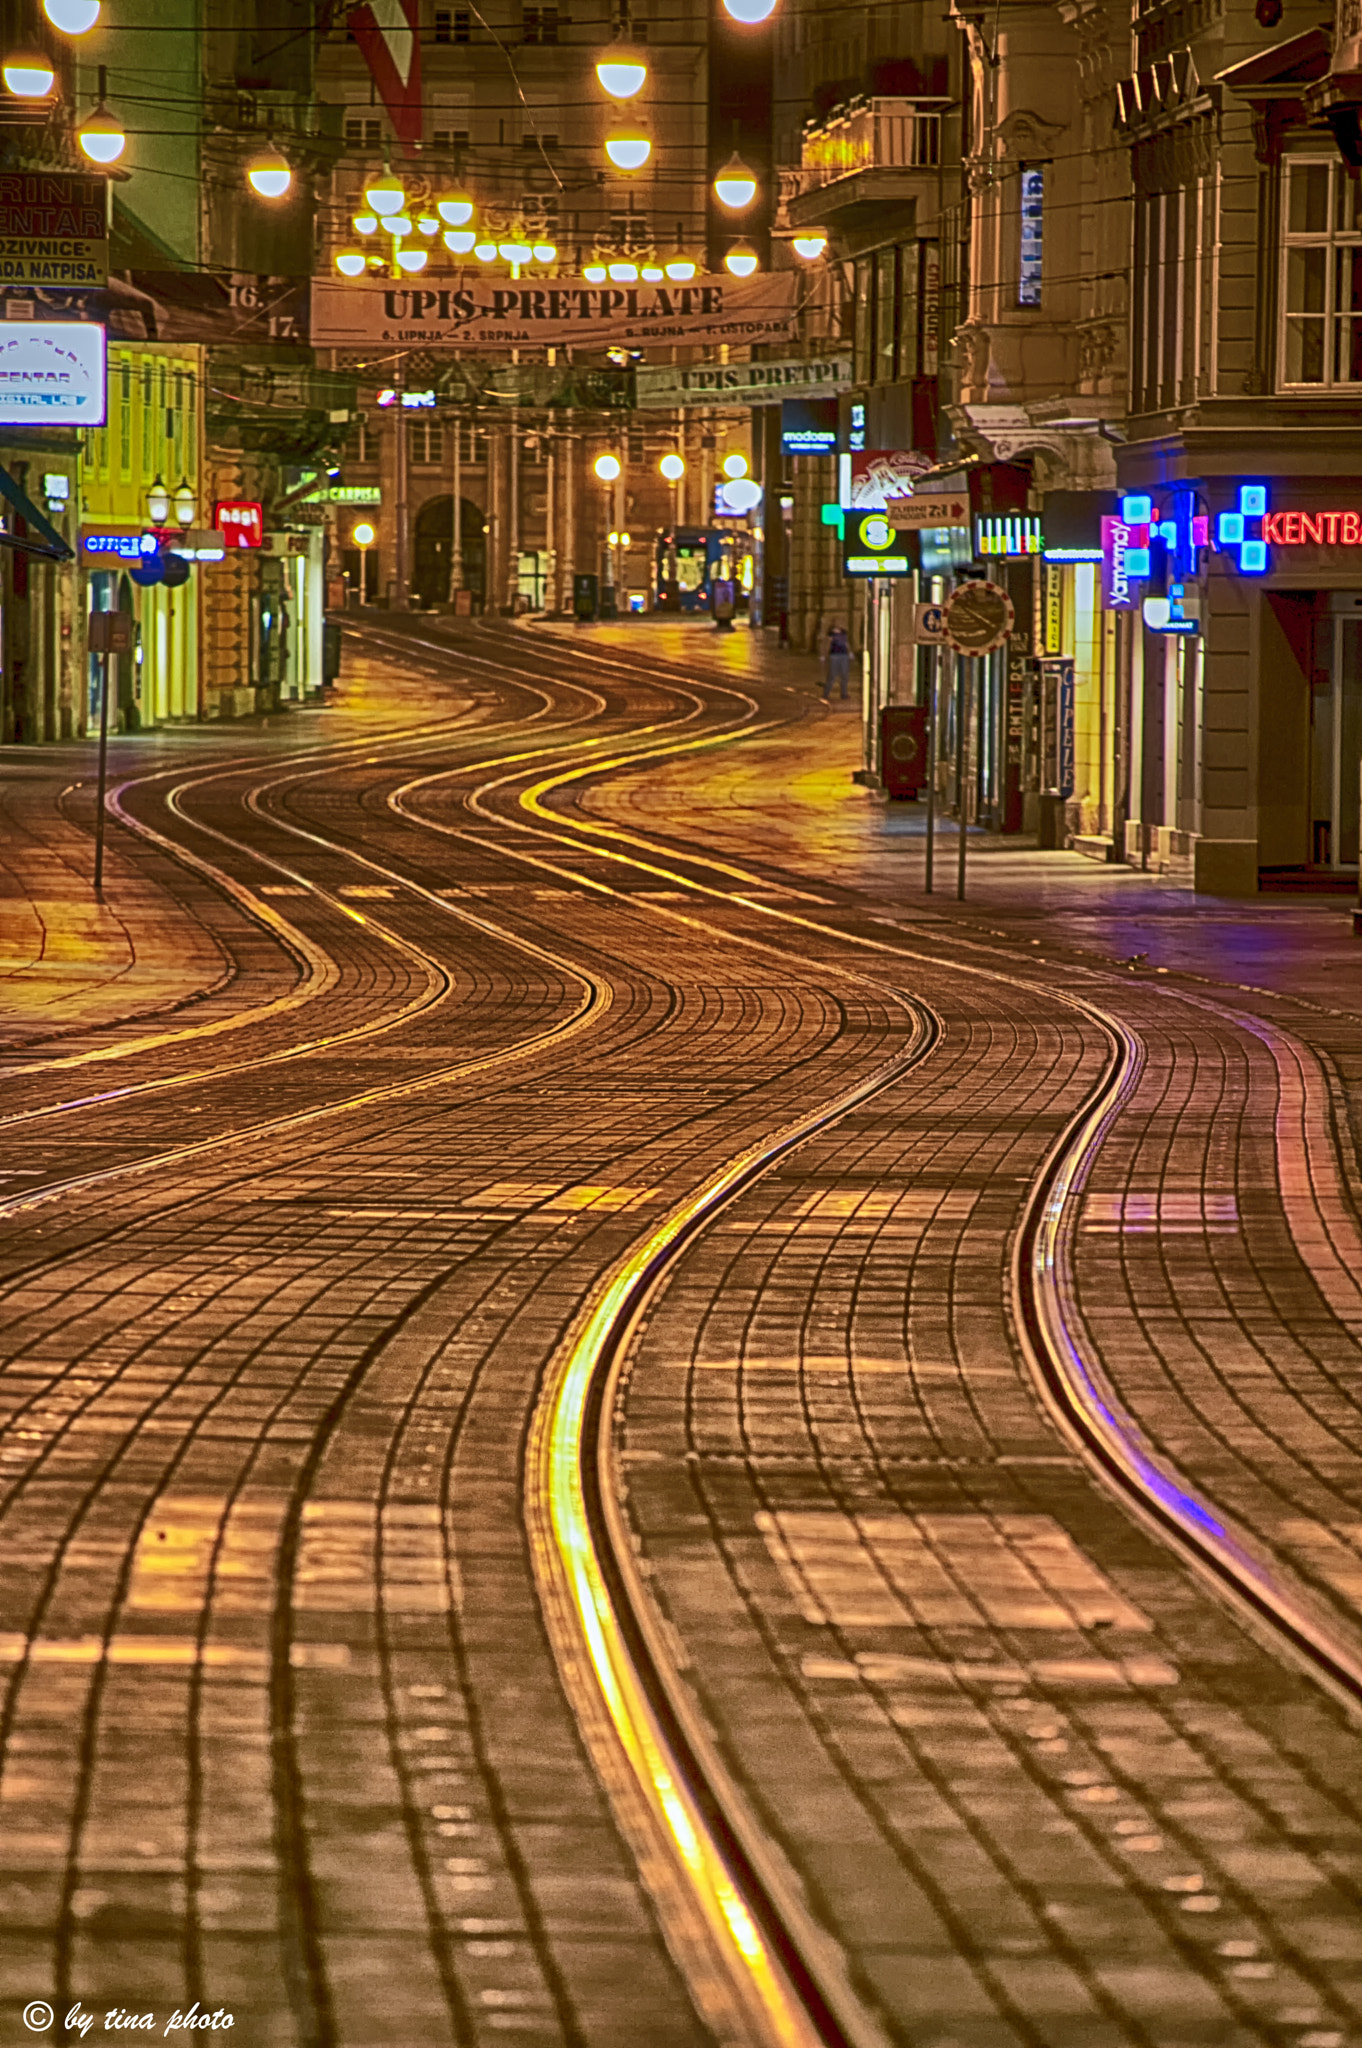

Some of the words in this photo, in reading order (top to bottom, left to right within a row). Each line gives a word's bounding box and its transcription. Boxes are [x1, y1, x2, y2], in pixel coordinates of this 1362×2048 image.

[0, 261, 25, 278] DA
[30, 262, 97, 280] NATPISA
[228, 287, 264, 308] 16.
[384, 289, 476, 320] UPIS
[492, 286, 723, 320] PRETPLATE
[268, 316, 299, 337] 17.
[398, 330, 443, 341] LIPNJA
[463, 330, 475, 341] 2.
[480, 330, 530, 341] SRPNJA
[1262, 511, 1362, 545] KENTB
